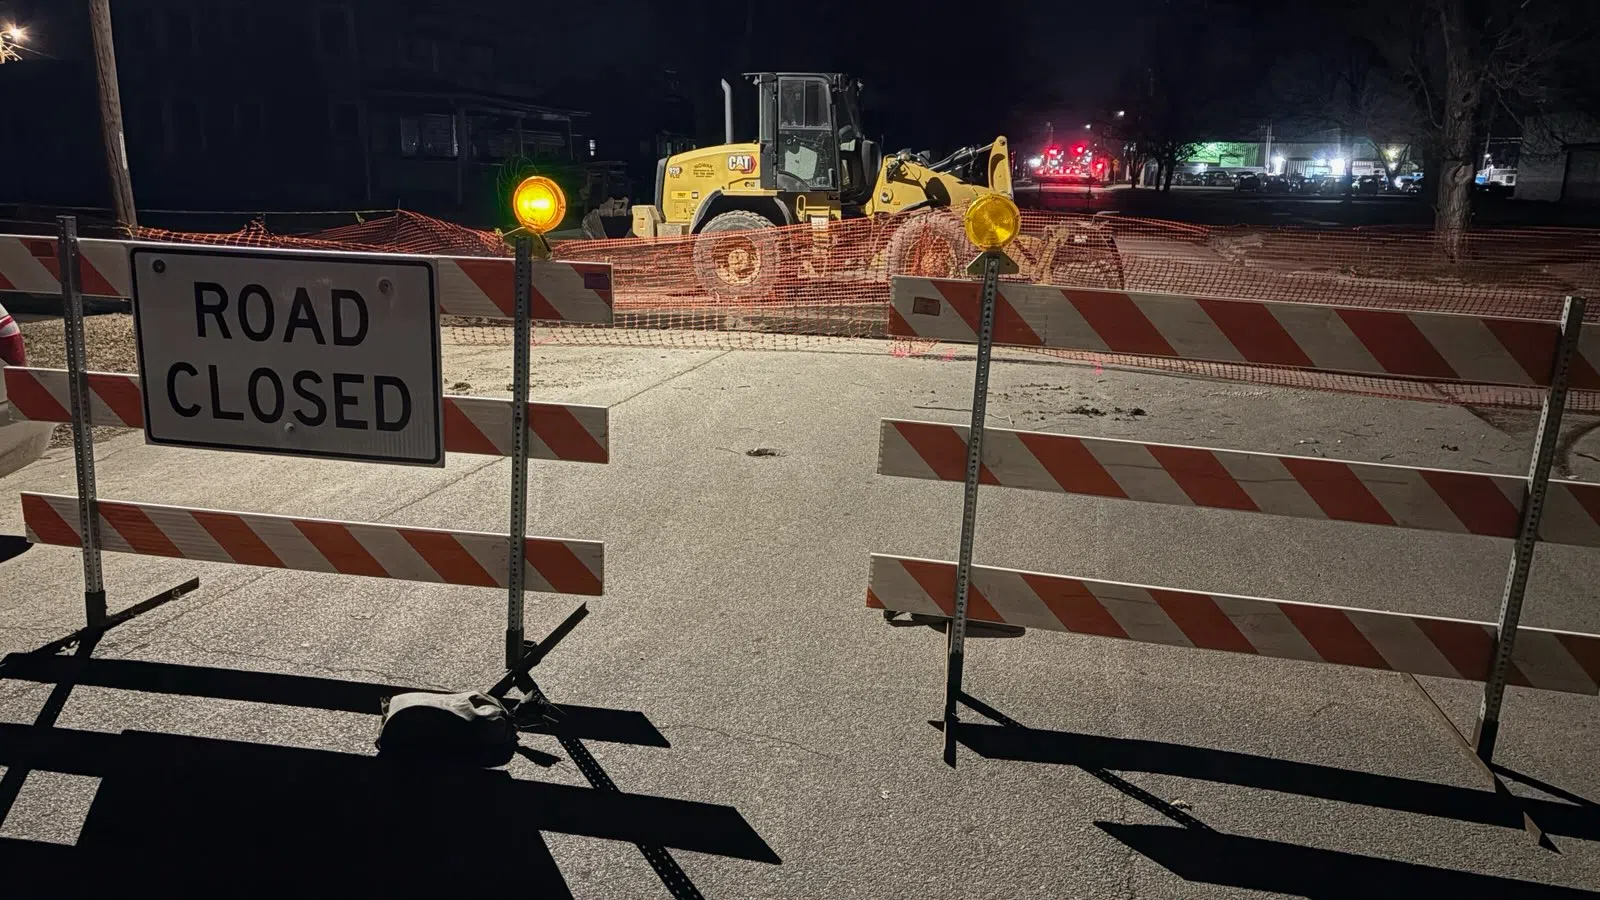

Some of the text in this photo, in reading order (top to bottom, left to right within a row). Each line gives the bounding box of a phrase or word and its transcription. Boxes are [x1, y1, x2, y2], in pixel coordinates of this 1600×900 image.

[728, 155, 750, 170] CAT
[194, 281, 369, 347] ROAD
[167, 361, 412, 432] CLOSED
